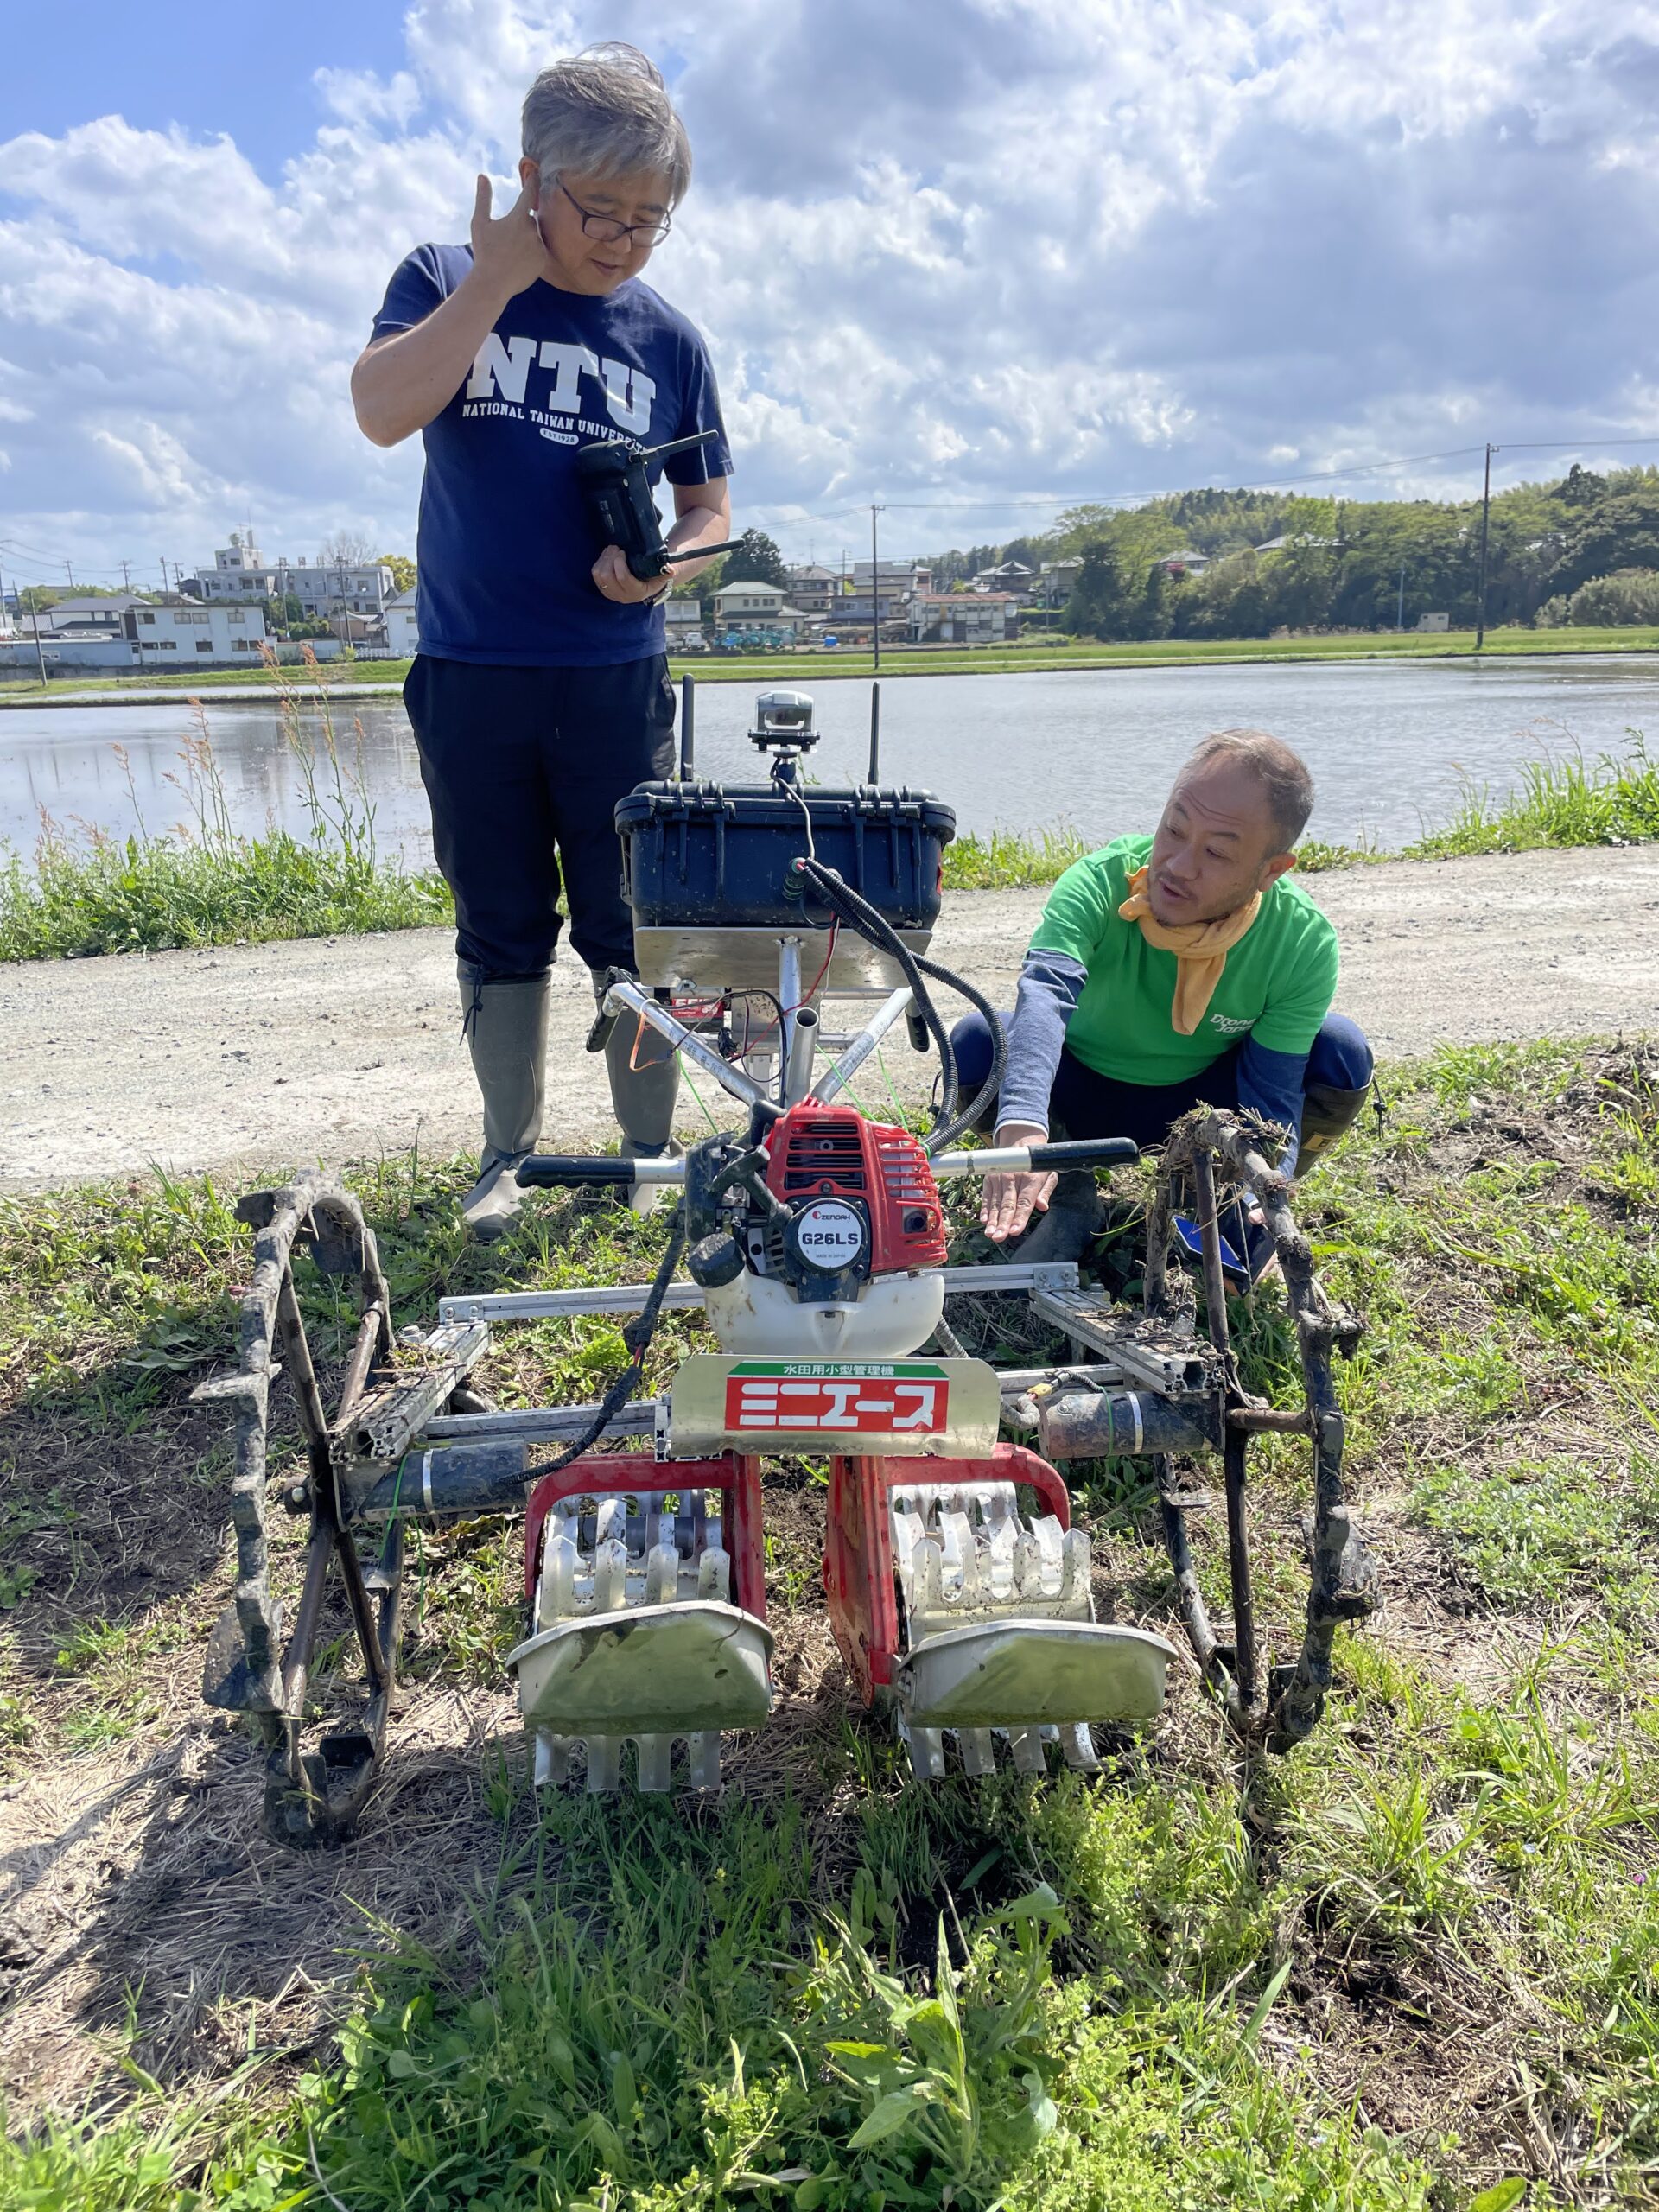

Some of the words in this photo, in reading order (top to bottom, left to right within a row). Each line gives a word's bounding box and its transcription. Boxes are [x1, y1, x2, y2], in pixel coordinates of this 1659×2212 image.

[466, 332, 656, 436] NTU
[462, 402, 525, 420] NATIONAL
[530, 410, 575, 430] TAIWAN
[802, 1233, 858, 1244] G26LS
[784, 1364, 895, 1376] 水田用小型管理機
[740, 1383, 935, 1429] ミニエース
